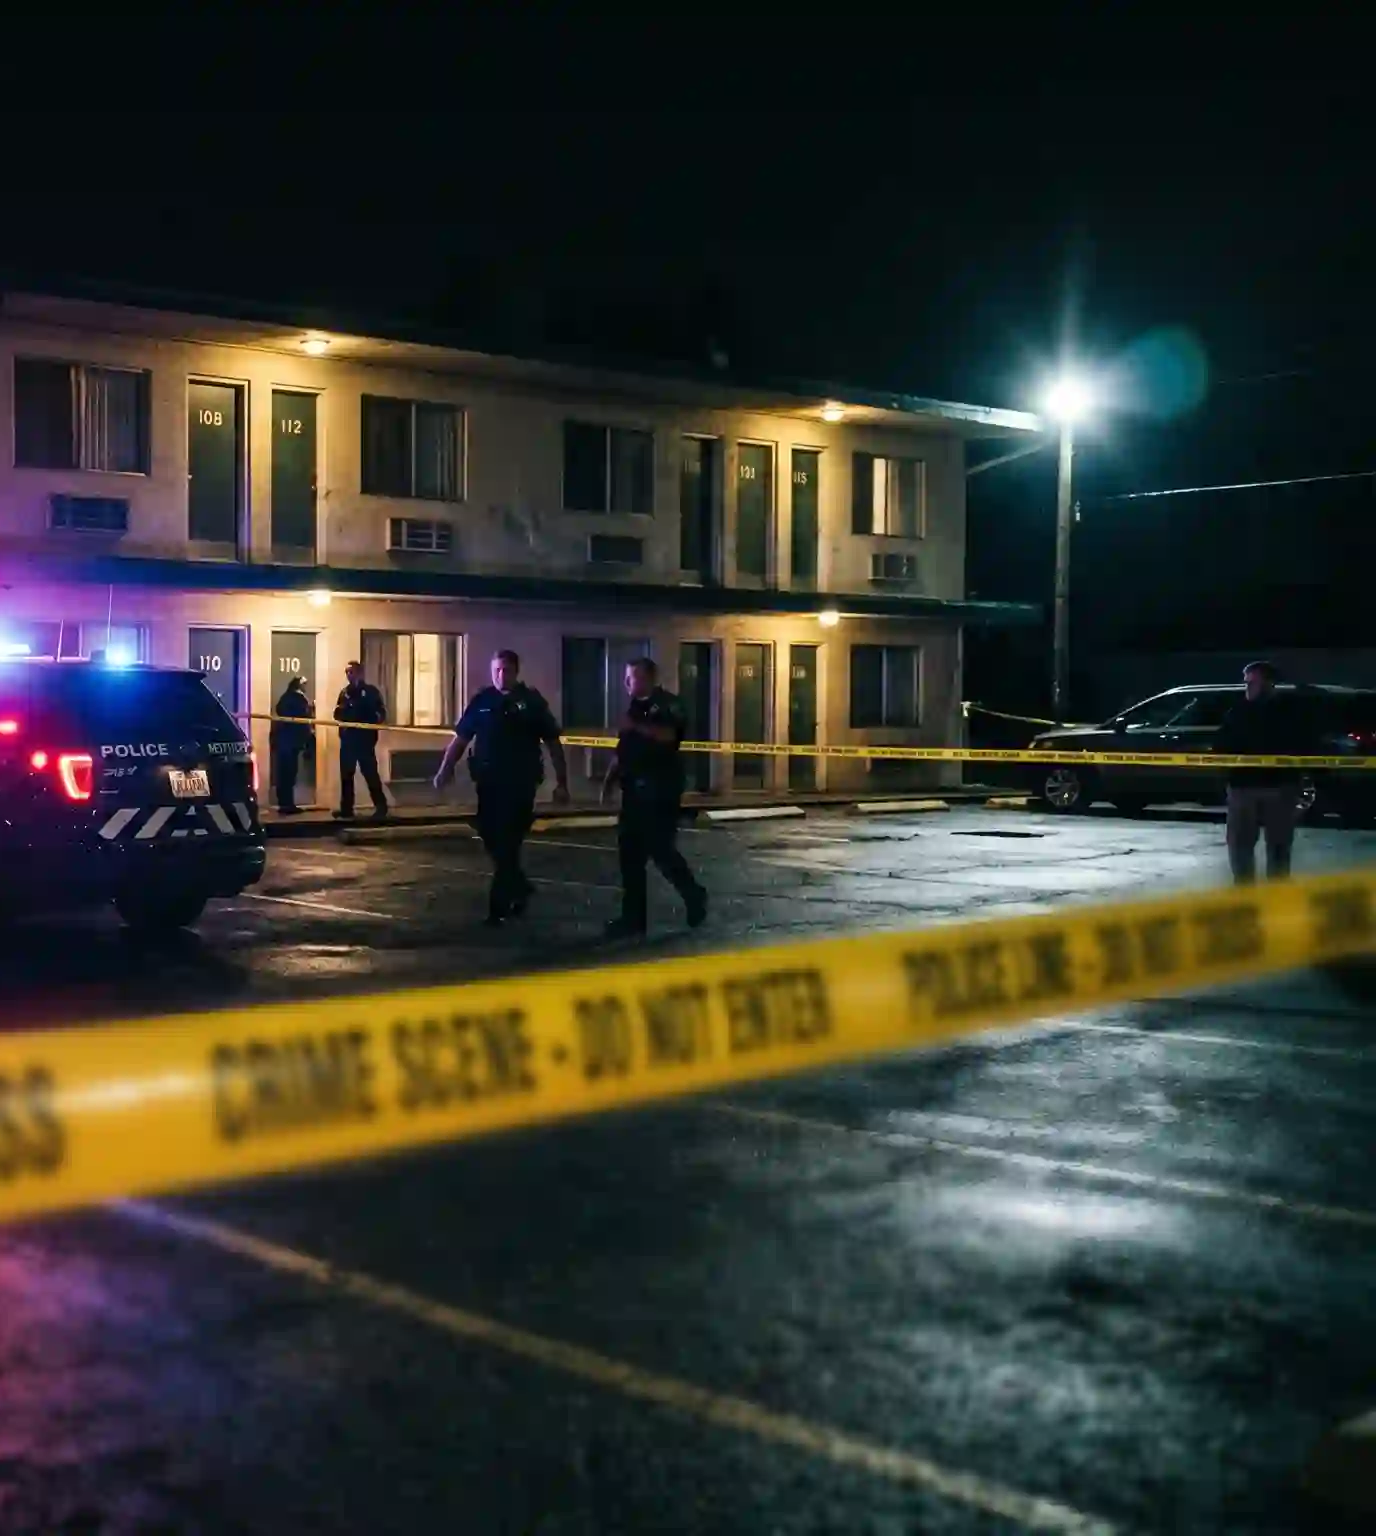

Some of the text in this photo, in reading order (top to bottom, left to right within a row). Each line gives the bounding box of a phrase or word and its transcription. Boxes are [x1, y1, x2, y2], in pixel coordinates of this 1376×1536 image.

[281, 419, 302, 434] 112
[200, 655, 221, 672] 110
[279, 657, 300, 673] 110
[101, 743, 169, 758] POLICE
[212, 1027, 377, 1144] CRIME
[389, 1005, 537, 1114] SCENE
[573, 994, 631, 1080] DO
[639, 981, 712, 1065] NOT
[721, 966, 832, 1054] ENTER
